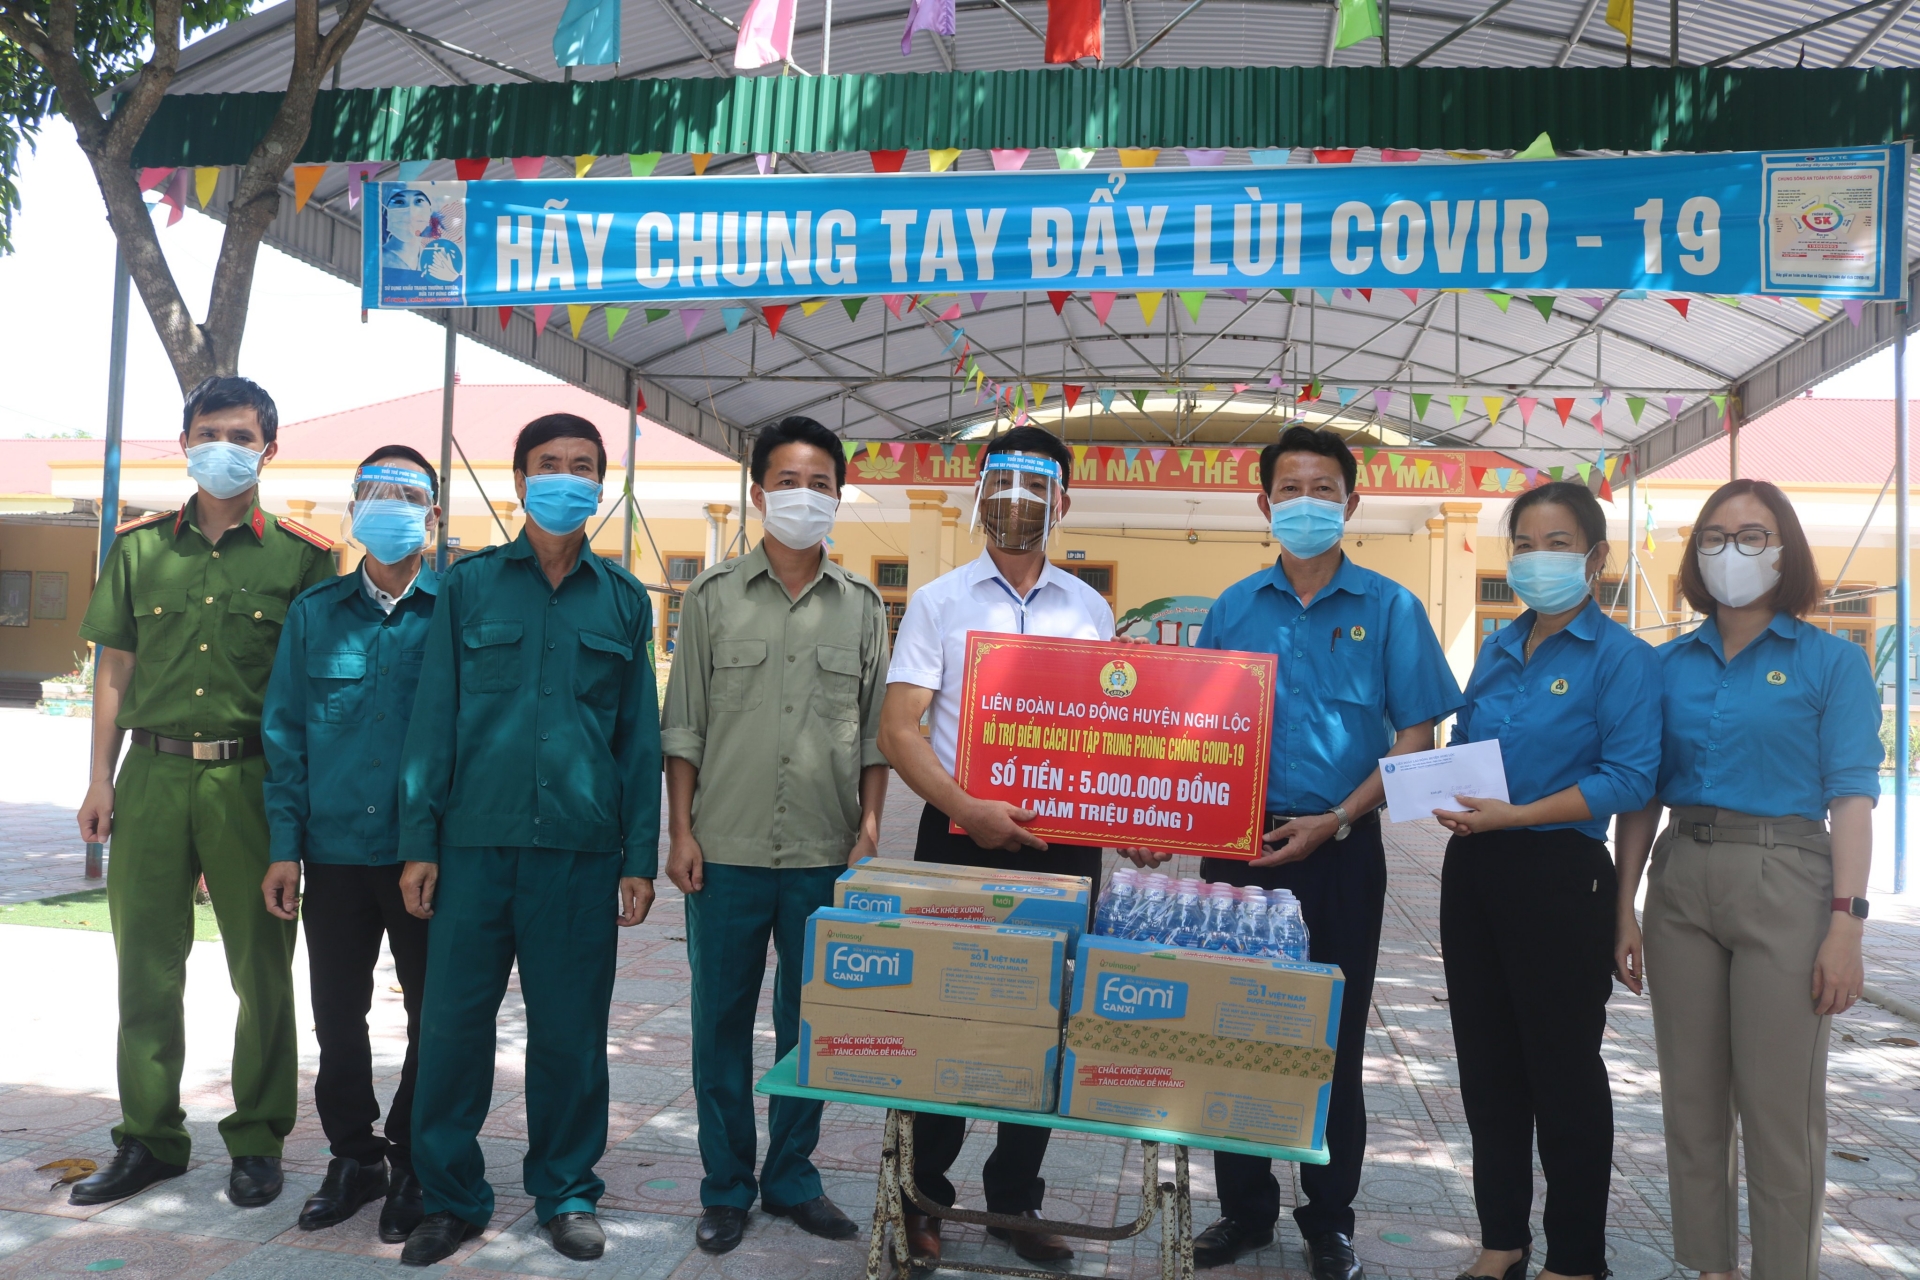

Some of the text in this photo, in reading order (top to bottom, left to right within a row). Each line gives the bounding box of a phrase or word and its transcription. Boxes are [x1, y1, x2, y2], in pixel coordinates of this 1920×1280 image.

[1814, 216, 1832, 225] 5K
[496, 199, 615, 292] HÃY
[635, 209, 858, 288] CHUNG
[881, 207, 1015, 284] TAY
[1028, 172, 1171, 279] ĐẨY
[1193, 186, 1301, 278] LÙI
[1329, 197, 1548, 276] COVID
[1632, 196, 1721, 276] 19
[1106, 458, 1161, 482] NAY
[981, 693, 1251, 734] LIÊN ĐOÀN LAO ĐỘNG HUYỆN NGHI LỘC
[982, 713, 1244, 766] HỖ TRỢ ĐIỂM CÁCH LY TẬP TRUNG PHÒNG CHỐNG COVID-19
[990, 756, 1018, 786] SỐ
[1022, 759, 1064, 791] TIỀN
[1079, 771, 1172, 801] 5.000.000
[1177, 773, 1230, 806] ĐỒNG
[1033, 798, 1073, 819] NĂM
[1079, 803, 1128, 826] TRIỆU
[1133, 807, 1181, 829] ĐỒNG
[982, 949, 989, 961] 1
[991, 955, 1008, 964] VIỆT
[1010, 957, 1028, 965] NAM
[970, 962, 987, 970] ĐƯỢC
[988, 963, 1005, 971] CHỌN
[833, 972, 863, 982] CANXI
[1248, 984, 1307, 1002] SỐ 1 VIỆT NAM
[1102, 1002, 1135, 1013] CANXI
[1265, 1000, 1283, 1008] CHỌN
[833, 1034, 904, 1045] CHẮC KHỎE XƯƠNG
[834, 1047, 853, 1056] TĂNG
[854, 1047, 879, 1056] CƯỜNG
[891, 1048, 916, 1056] KHÁNG
[1098, 1063, 1172, 1076] CHẮC KHỎE XƯƠNG
[1098, 1078, 1119, 1086] TĂNG
[1119, 1078, 1145, 1086] CƯỜNG
[1157, 1079, 1184, 1087] KHÁNG
